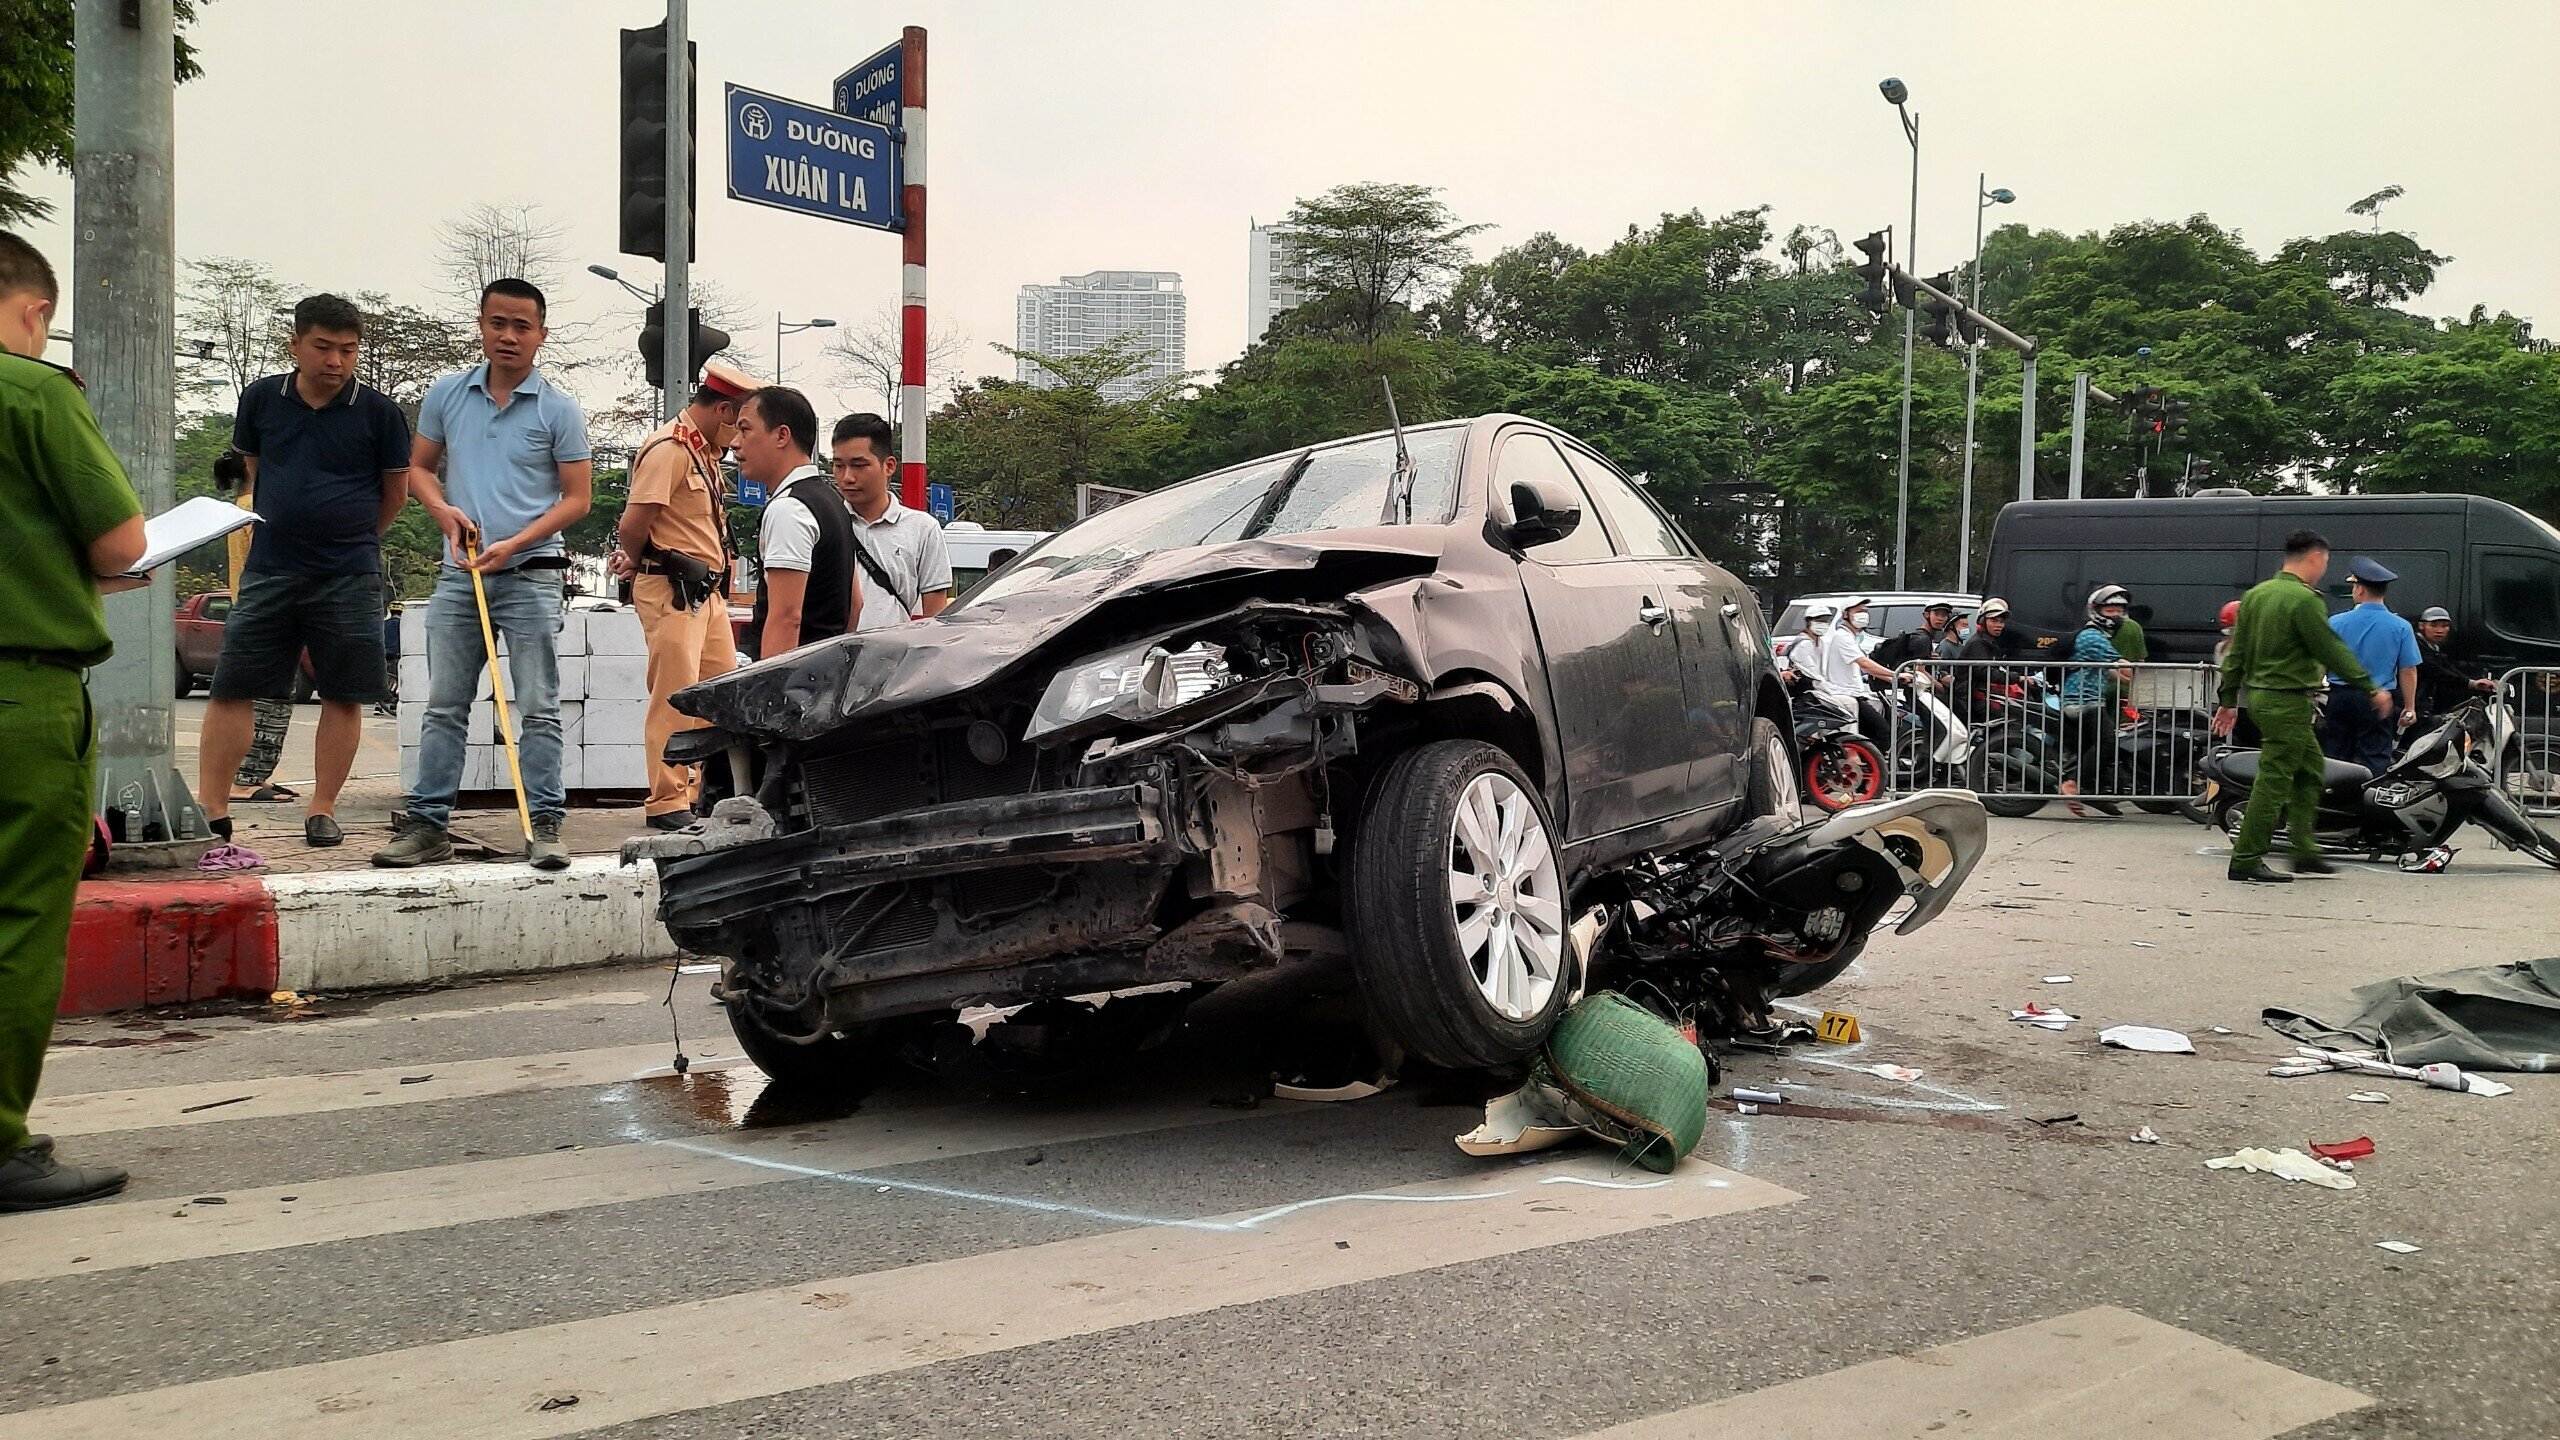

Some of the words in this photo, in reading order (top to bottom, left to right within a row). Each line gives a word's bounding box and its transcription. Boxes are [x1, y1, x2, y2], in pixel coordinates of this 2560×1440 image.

[787, 119, 875, 160] ĐƯỜNG
[764, 155, 828, 204] XUÂN
[838, 171, 867, 212] LA
[857, 550, 876, 572] Canon
[2036, 637, 2058, 649] 29
[1826, 1016, 1849, 1038] 17
